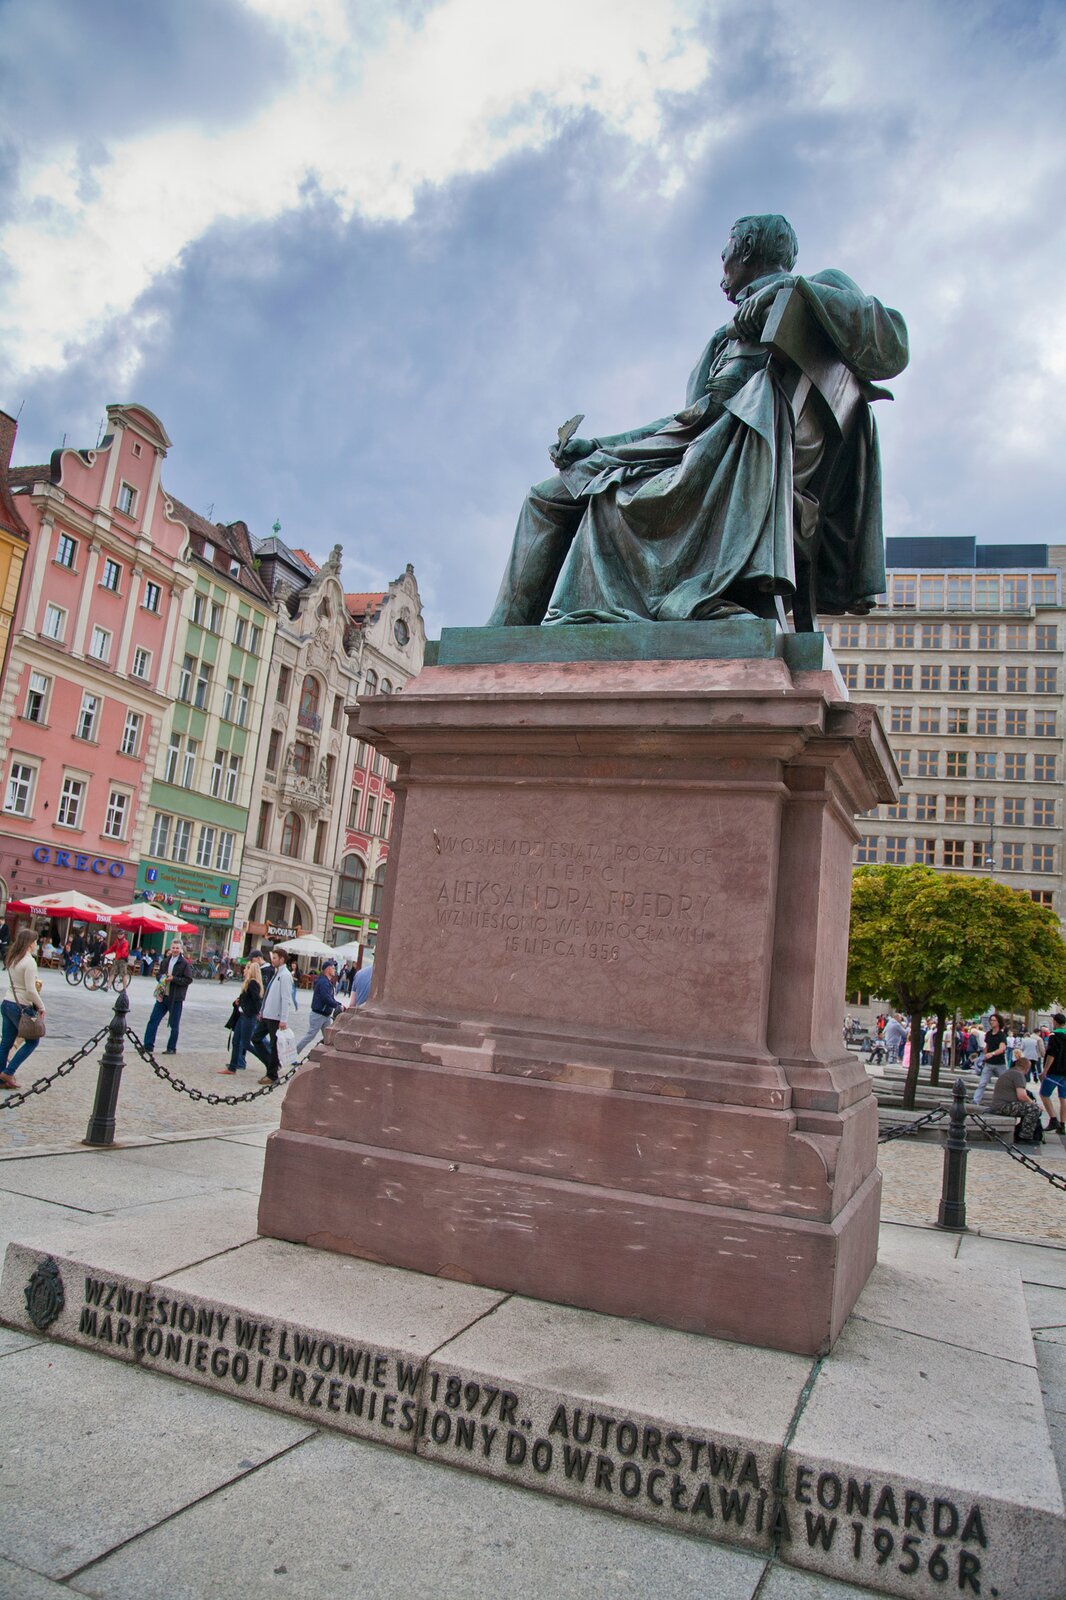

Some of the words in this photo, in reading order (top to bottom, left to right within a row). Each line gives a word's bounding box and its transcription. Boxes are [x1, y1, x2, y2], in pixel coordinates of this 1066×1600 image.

[33, 846, 125, 878] GRECO
[437, 879, 593, 914] ALEKSANDRA
[607, 889, 712, 922] FREDRY
[505, 936, 521, 952] 15
[556, 918, 580, 936] WE
[79, 1307, 249, 1384] MARCONIEGO
[271, 1363, 496, 1457] PRZENIESIONY
[505, 1430, 551, 1473] DO
[563, 1446, 790, 1541] WROCŁAWIA
[805, 1510, 837, 1550] W
[85, 1276, 230, 1341] WZNIESIONY
[235, 1317, 273, 1355] WE
[278, 1331, 387, 1388] LWOWIE
[396, 1360, 422, 1396] W
[550, 1404, 760, 1489] AUTORSTWA
[773, 1457, 987, 1548] LEONARDA
